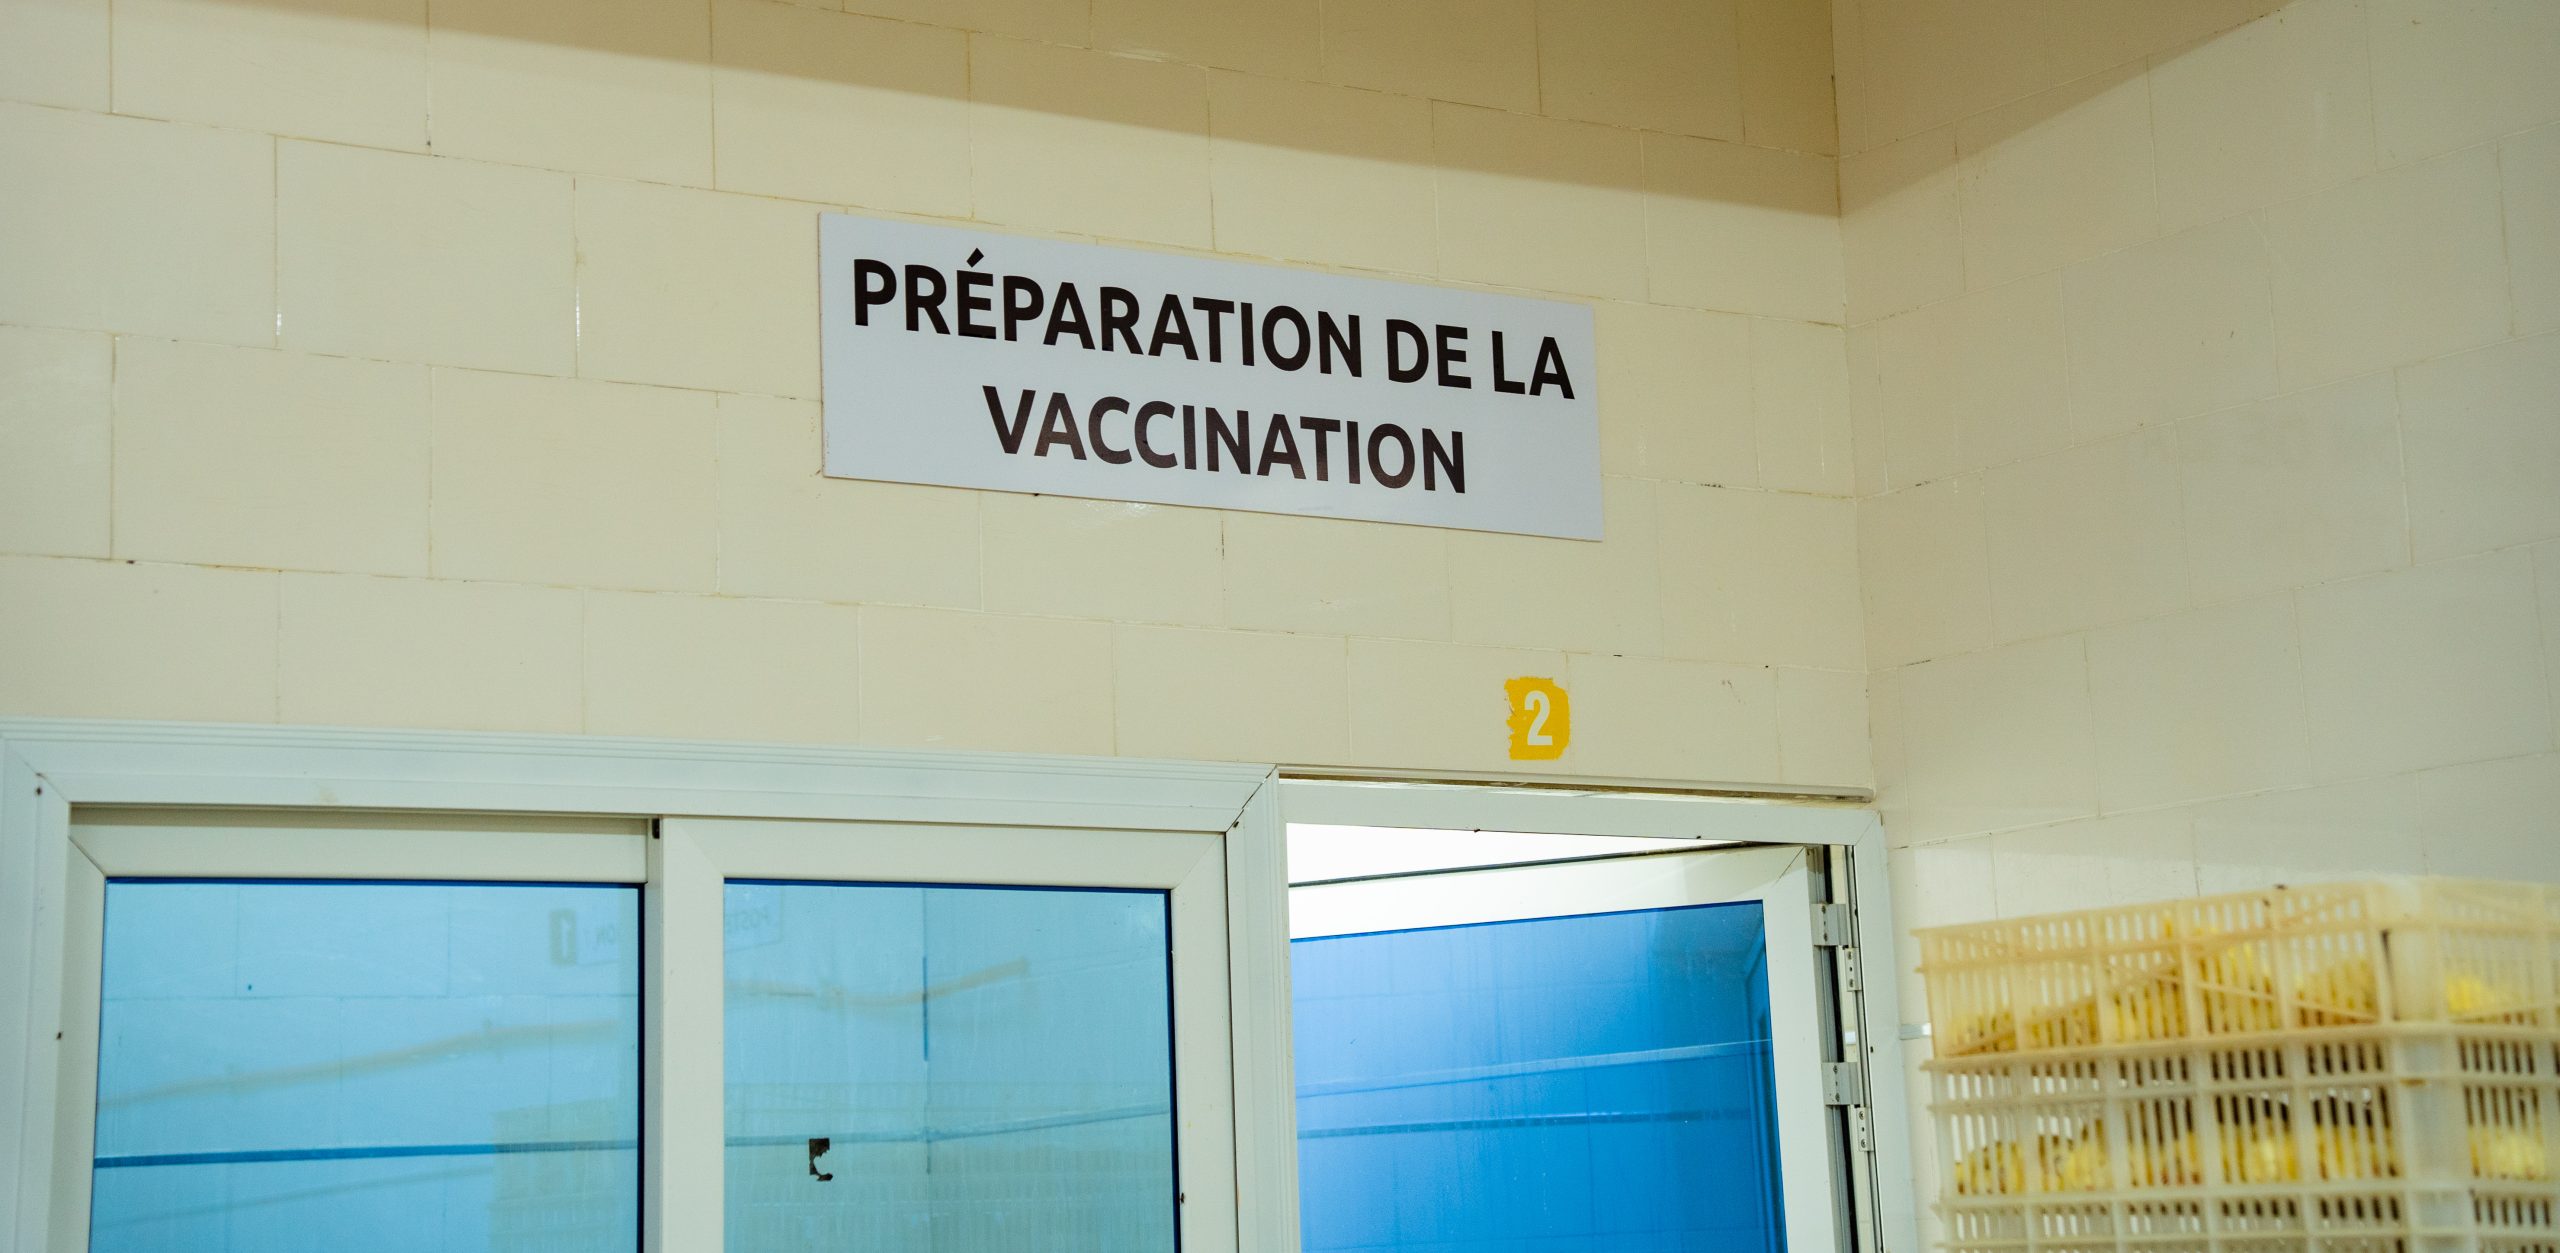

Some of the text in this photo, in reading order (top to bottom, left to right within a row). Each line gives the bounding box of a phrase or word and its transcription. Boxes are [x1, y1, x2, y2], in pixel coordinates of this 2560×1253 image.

[853, 247, 1576, 400] PRÉPARATION DE LA
[982, 385, 1467, 494] VACCINATION
[1524, 689, 1553, 746] 2
